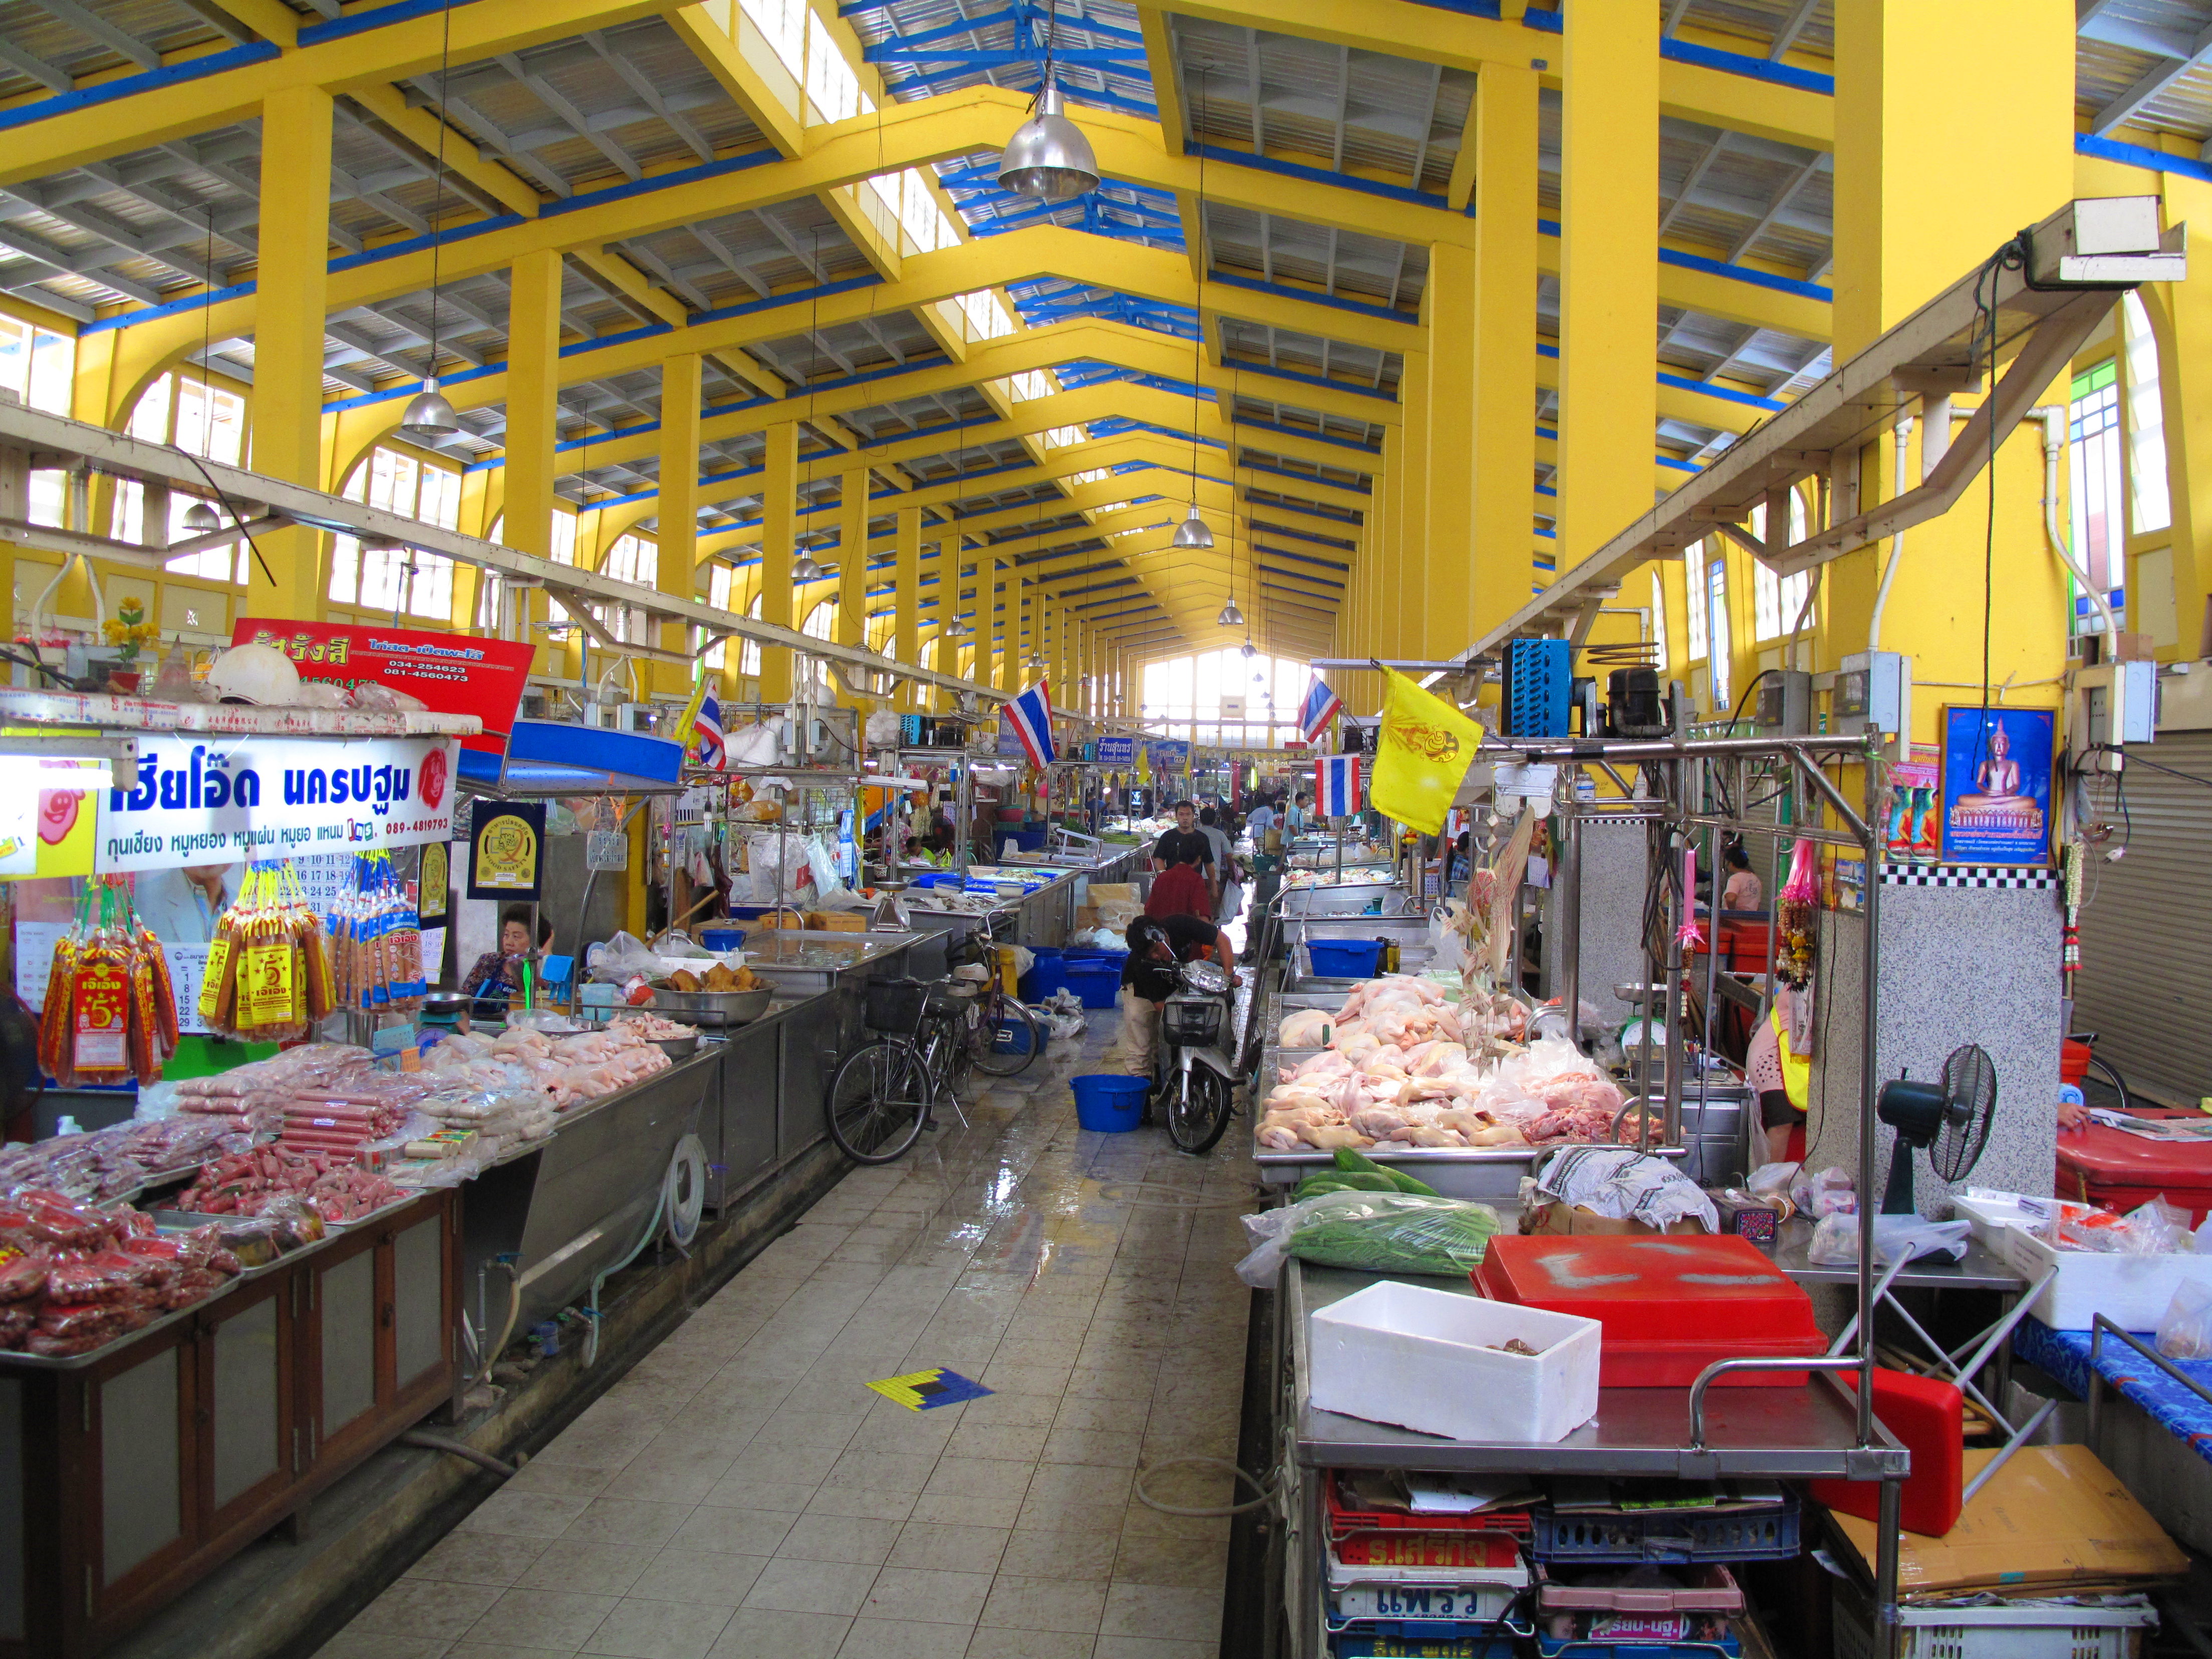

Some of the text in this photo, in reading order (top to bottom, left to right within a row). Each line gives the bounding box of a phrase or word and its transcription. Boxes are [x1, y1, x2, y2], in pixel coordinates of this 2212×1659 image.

[389, 660, 466, 673] 034-254623
[384, 668, 469, 682] 081-4560473
[284, 765, 411, 815] นครปฐม
[108, 829, 163, 863] กุนเชียง
[171, 832, 226, 858] หมูหยอง
[234, 825, 275, 853] หมูแผ่น
[281, 826, 311, 849] หมูยอ
[317, 824, 344, 841] แหนม
[312, 855, 322, 865] 10
[326, 855, 335, 865] 11
[486, 855, 527, 872] FOOD SAFETY
[297, 870, 307, 880] 16
[311, 871, 322, 880] 17
[326, 870, 336, 880] 18
[310, 886, 322, 896] 24
[325, 886, 336, 896] 25
[311, 902, 321, 912] 31
[185, 973, 189, 981] 1
[264, 960, 281, 986] 5
[184, 984, 190, 993] 8
[180, 995, 190, 1004] 15
[92, 999, 112, 1027] 5
[179, 1006, 190, 1015] 22
[179, 1018, 190, 1027] 29
[1377, 1588, 1477, 1614] แพรว
